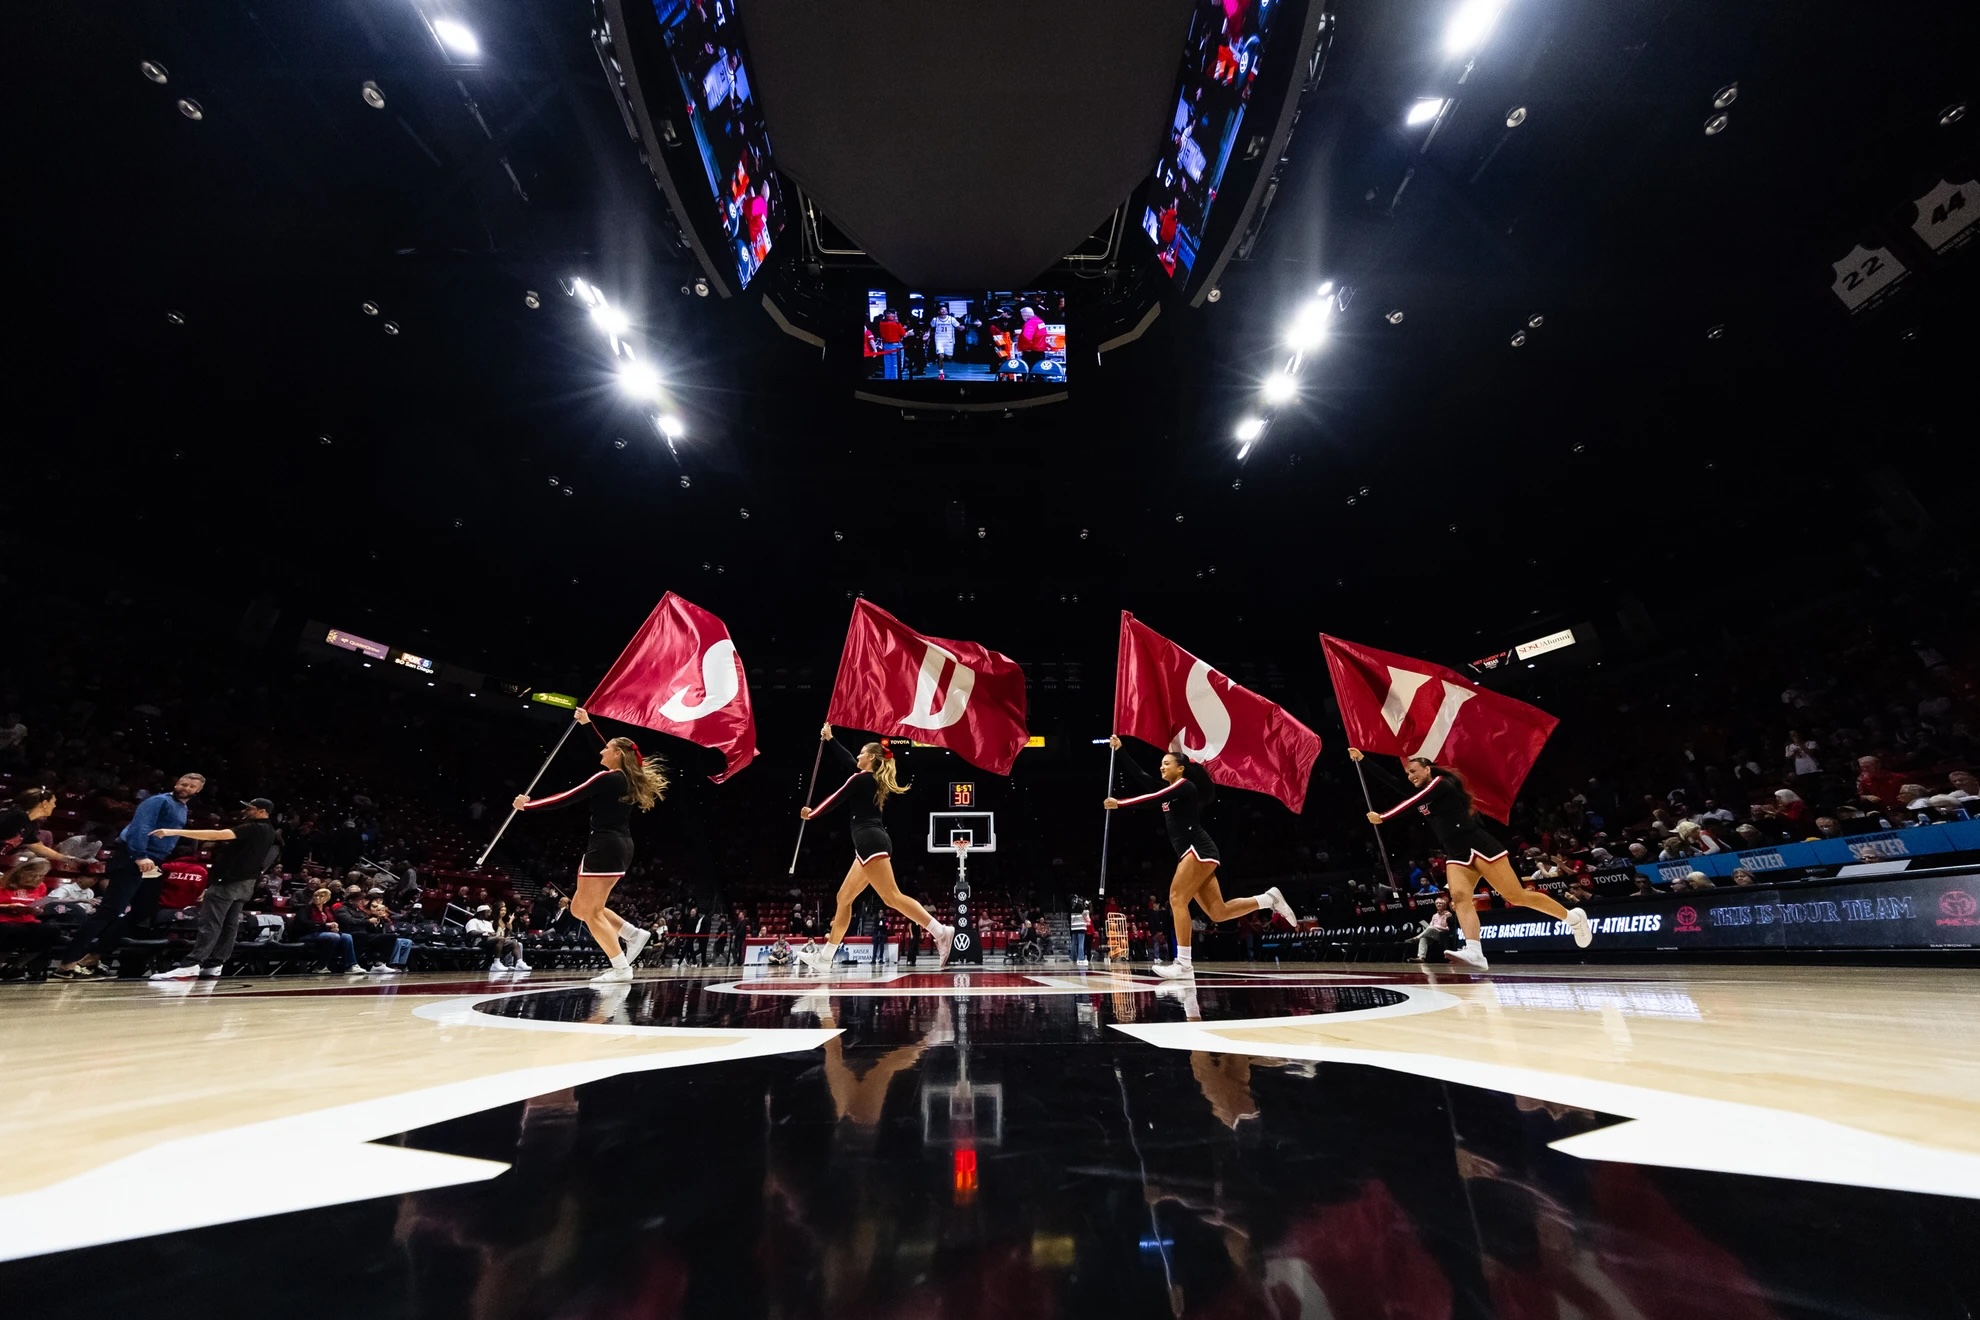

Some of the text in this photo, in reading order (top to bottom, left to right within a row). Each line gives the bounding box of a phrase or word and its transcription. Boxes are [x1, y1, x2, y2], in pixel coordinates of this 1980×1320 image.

[1931, 190, 1965, 226] 44
[1842, 256, 1885, 291] 22
[1518, 633, 1571, 653] SDSU Alumni
[402, 652, 422, 665] FOX
[405, 661, 417, 669] San
[416, 664, 434, 674] Diego
[899, 636, 976, 731] D
[1168, 659, 1237, 764] S
[956, 784, 972, 792] 6:57
[954, 792, 970, 804] 30
[1866, 832, 1899, 842] LIGHT
[1756, 848, 1777, 856] LIGHT
[1739, 853, 1787, 871] SELTZER
[168, 872, 202, 882] ELITE
[1594, 873, 1630, 885] TOYOTA
[1538, 881, 1568, 890] TOYOTA
[1416, 898, 1435, 906] TOYOTA
[1710, 896, 1916, 926] THIS IS YOUR TEAM
[1479, 925, 1498, 939] ZTEC
[1498, 921, 1551, 939] BASKETBALL
